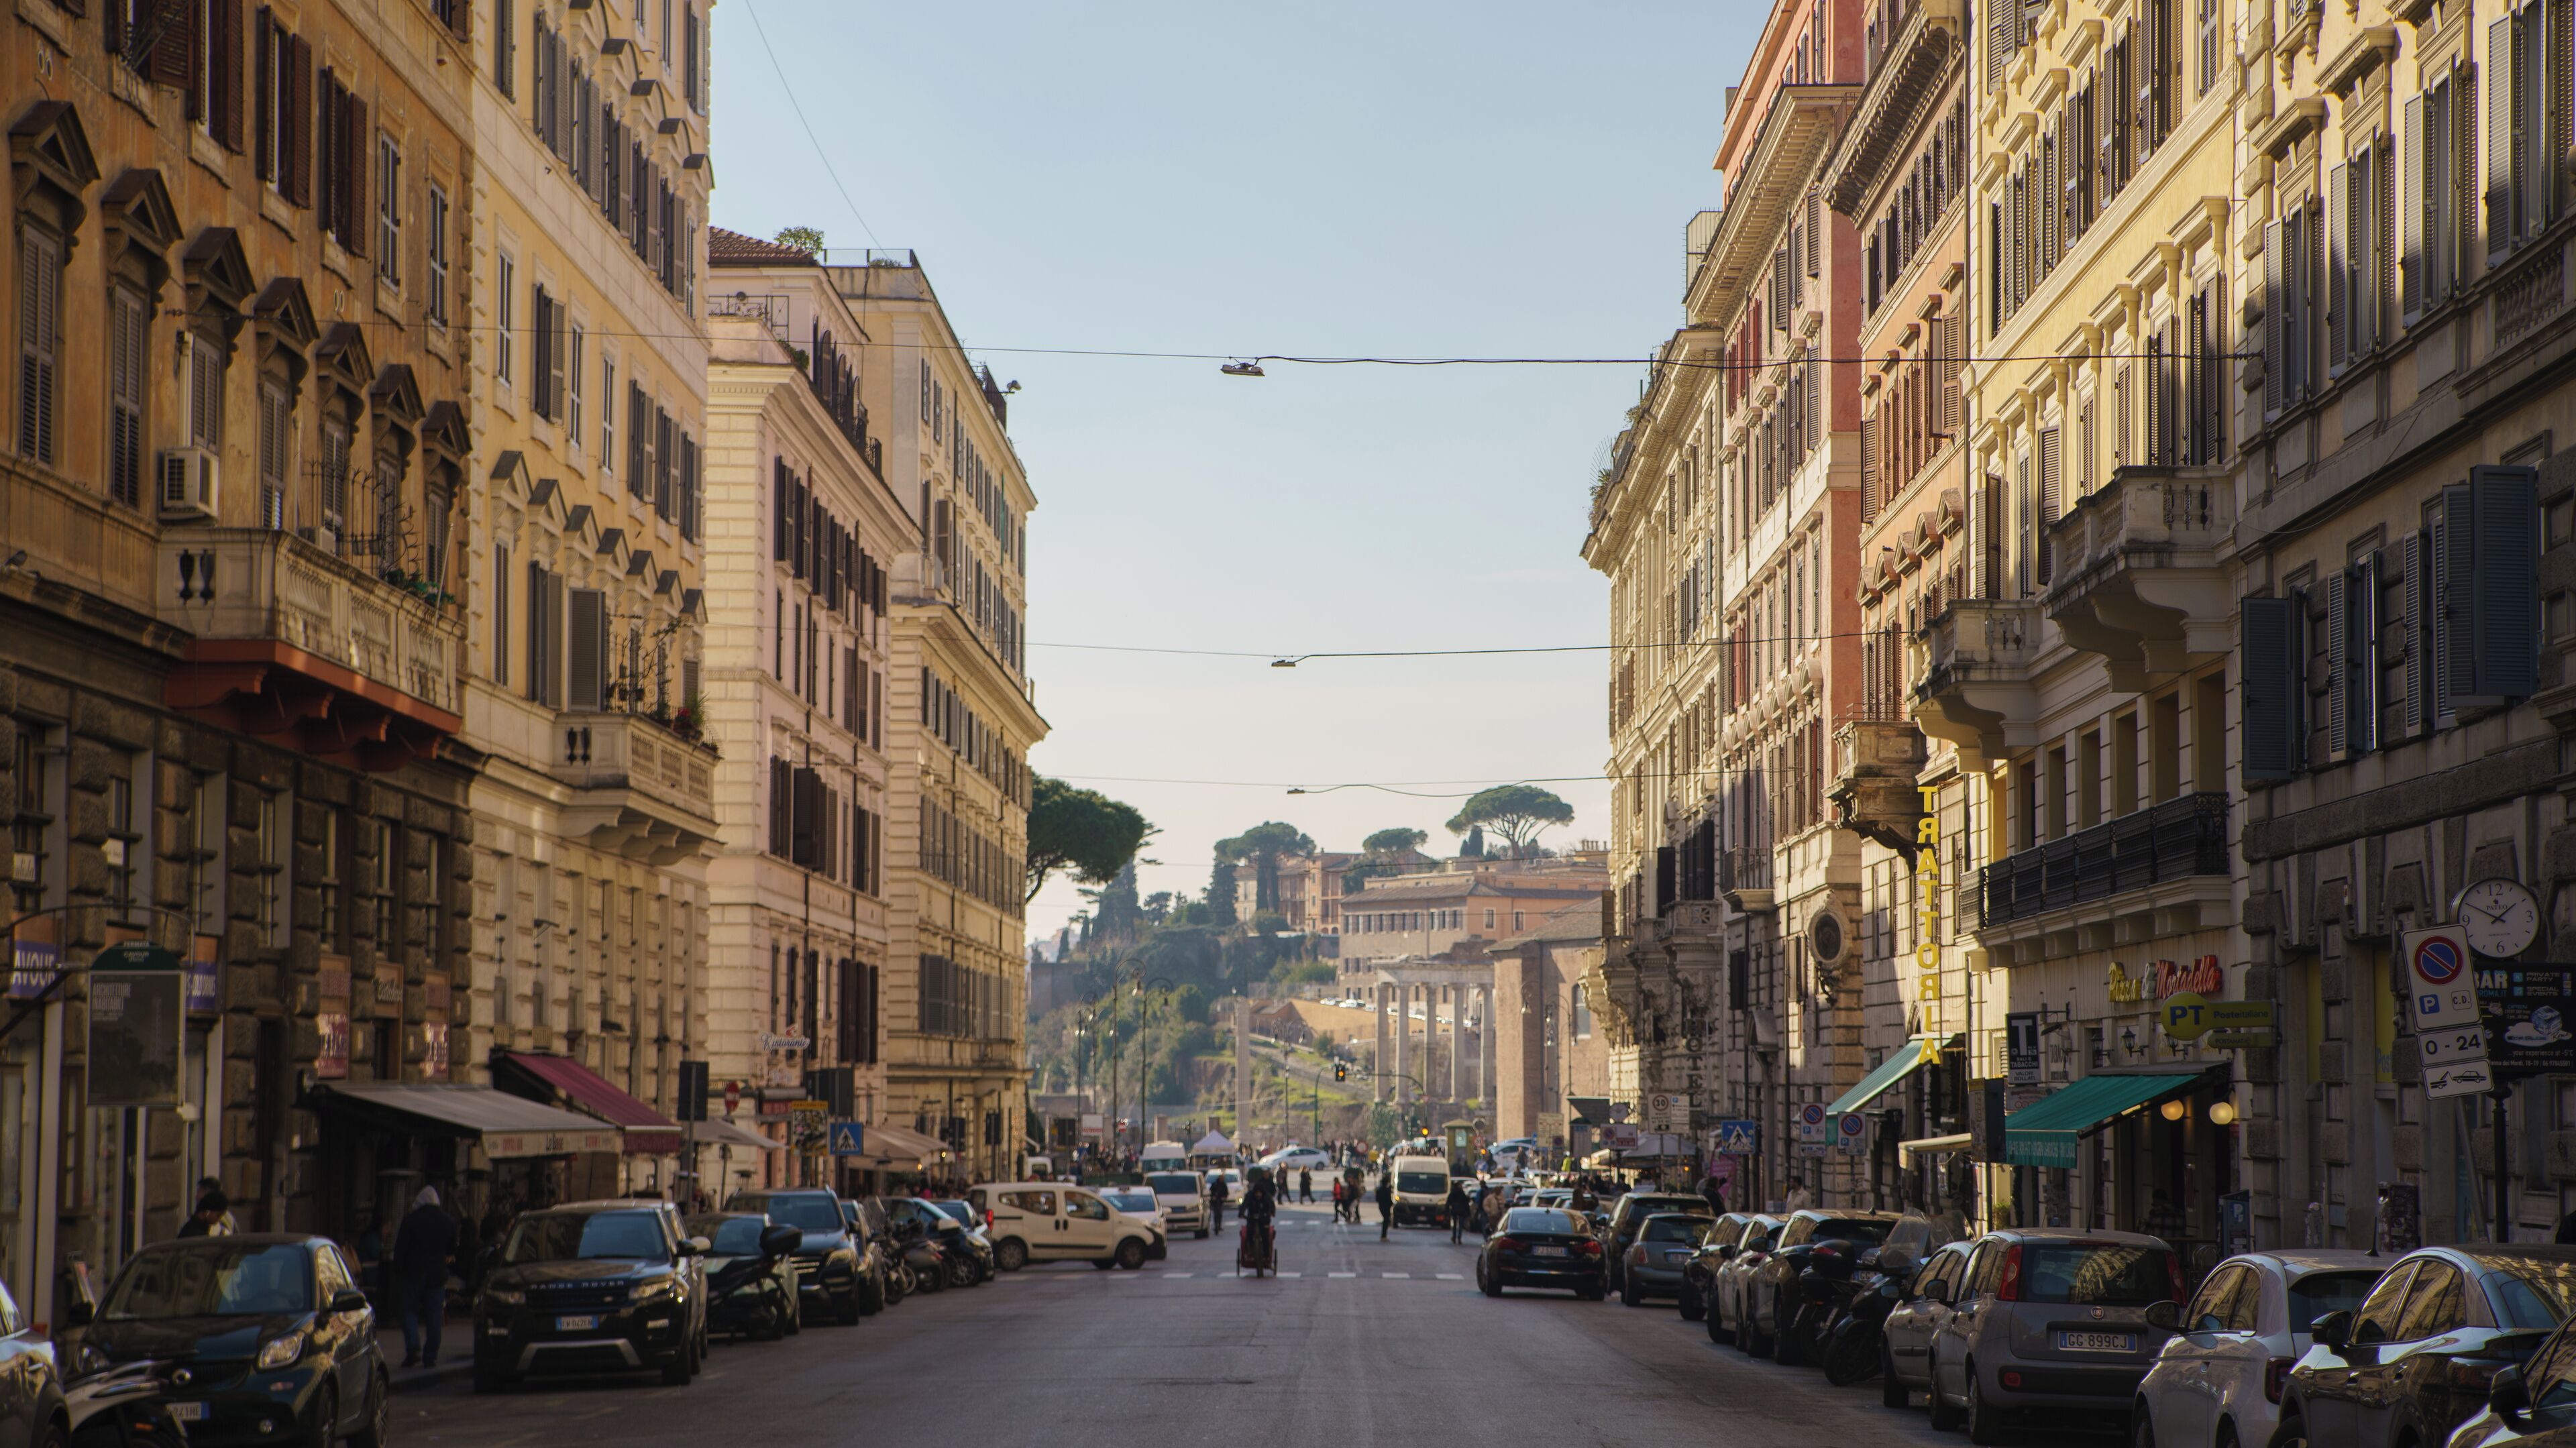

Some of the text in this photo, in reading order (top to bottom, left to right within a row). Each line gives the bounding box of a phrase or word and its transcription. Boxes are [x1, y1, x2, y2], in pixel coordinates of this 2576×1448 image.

[2487, 883, 2504, 896] 12
[2462, 914, 2470, 926] 9
[2526, 910, 2534, 923] 3
[2496, 940, 2505, 953] 6
[2108, 961, 2140, 1002] Pizza
[2155, 954, 2223, 1000] Mortadella
[2453, 995, 2470, 1005] C.D.
[2169, 1005, 2205, 1026] PT
[2213, 1010, 2269, 1019] Posteitaliane
[2011, 1020, 2032, 1055] T
[2426, 1040, 2438, 1055] 0
[2456, 1035, 2481, 1050] 24
[2068, 1334, 2127, 1348] GG 899CJ
